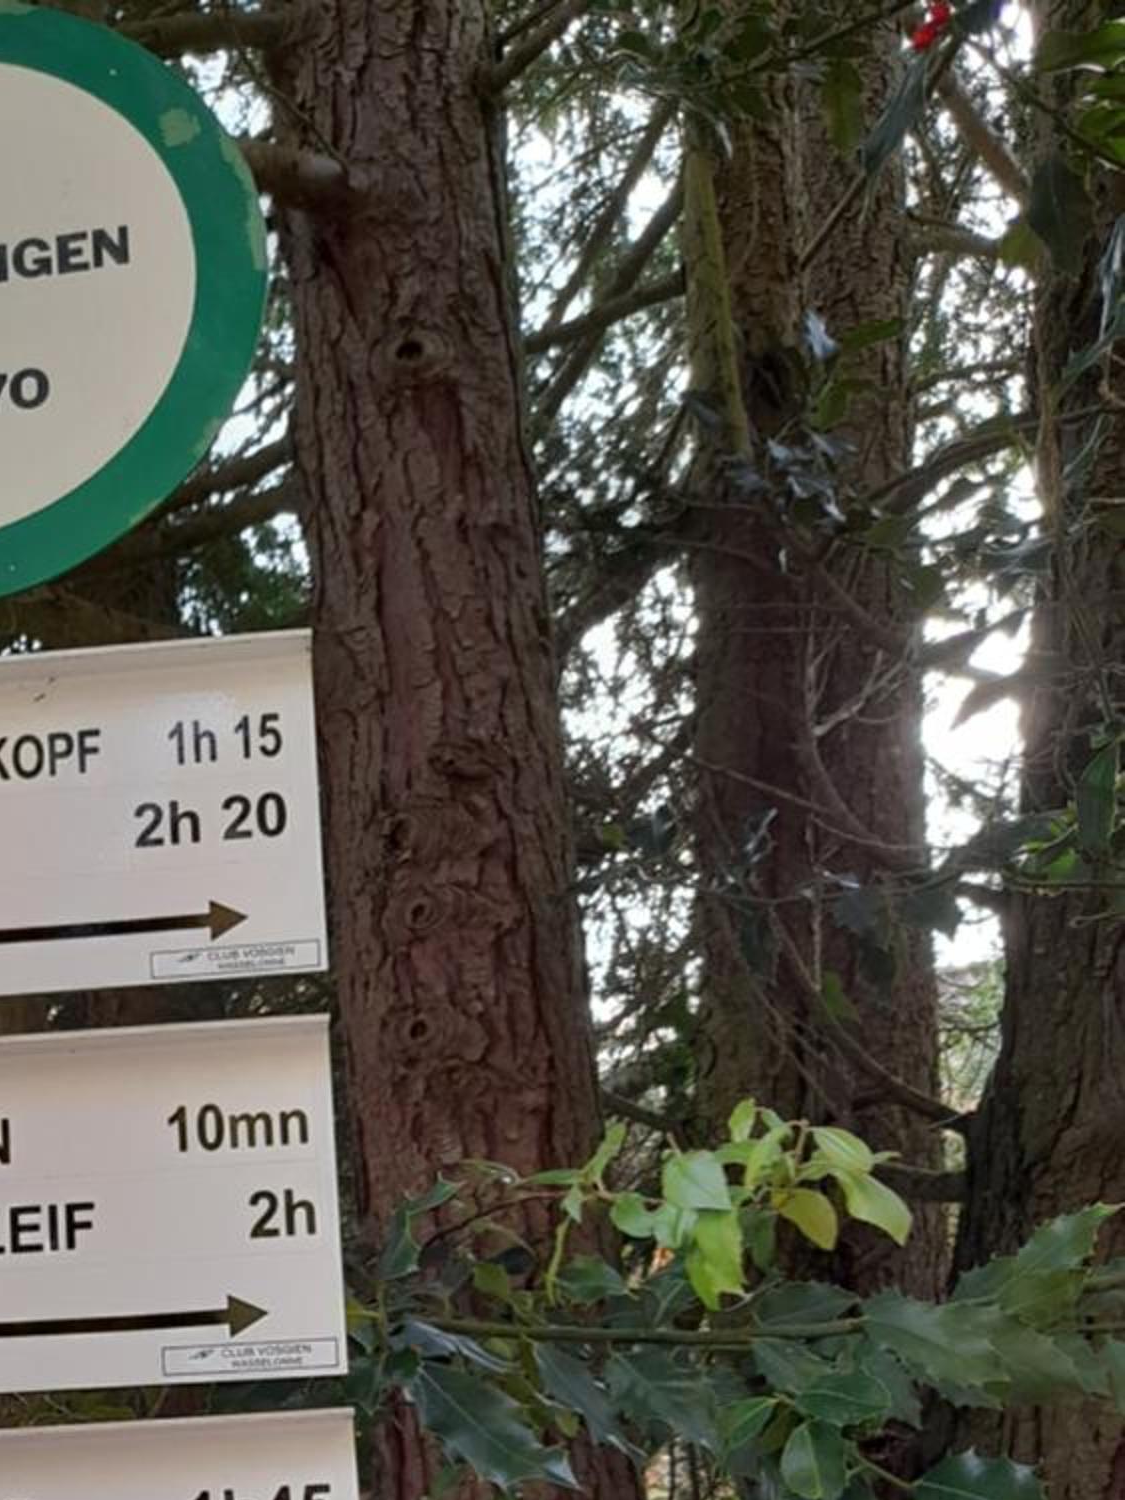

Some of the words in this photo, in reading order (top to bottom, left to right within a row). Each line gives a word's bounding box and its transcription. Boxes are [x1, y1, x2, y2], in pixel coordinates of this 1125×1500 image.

[167, 719, 218, 766] 1h
[234, 712, 283, 760] 15
[134, 800, 201, 849] 2h
[221, 791, 287, 841] 20
[167, 1103, 309, 1153] 10mn
[248, 1188, 317, 1239] 2h
